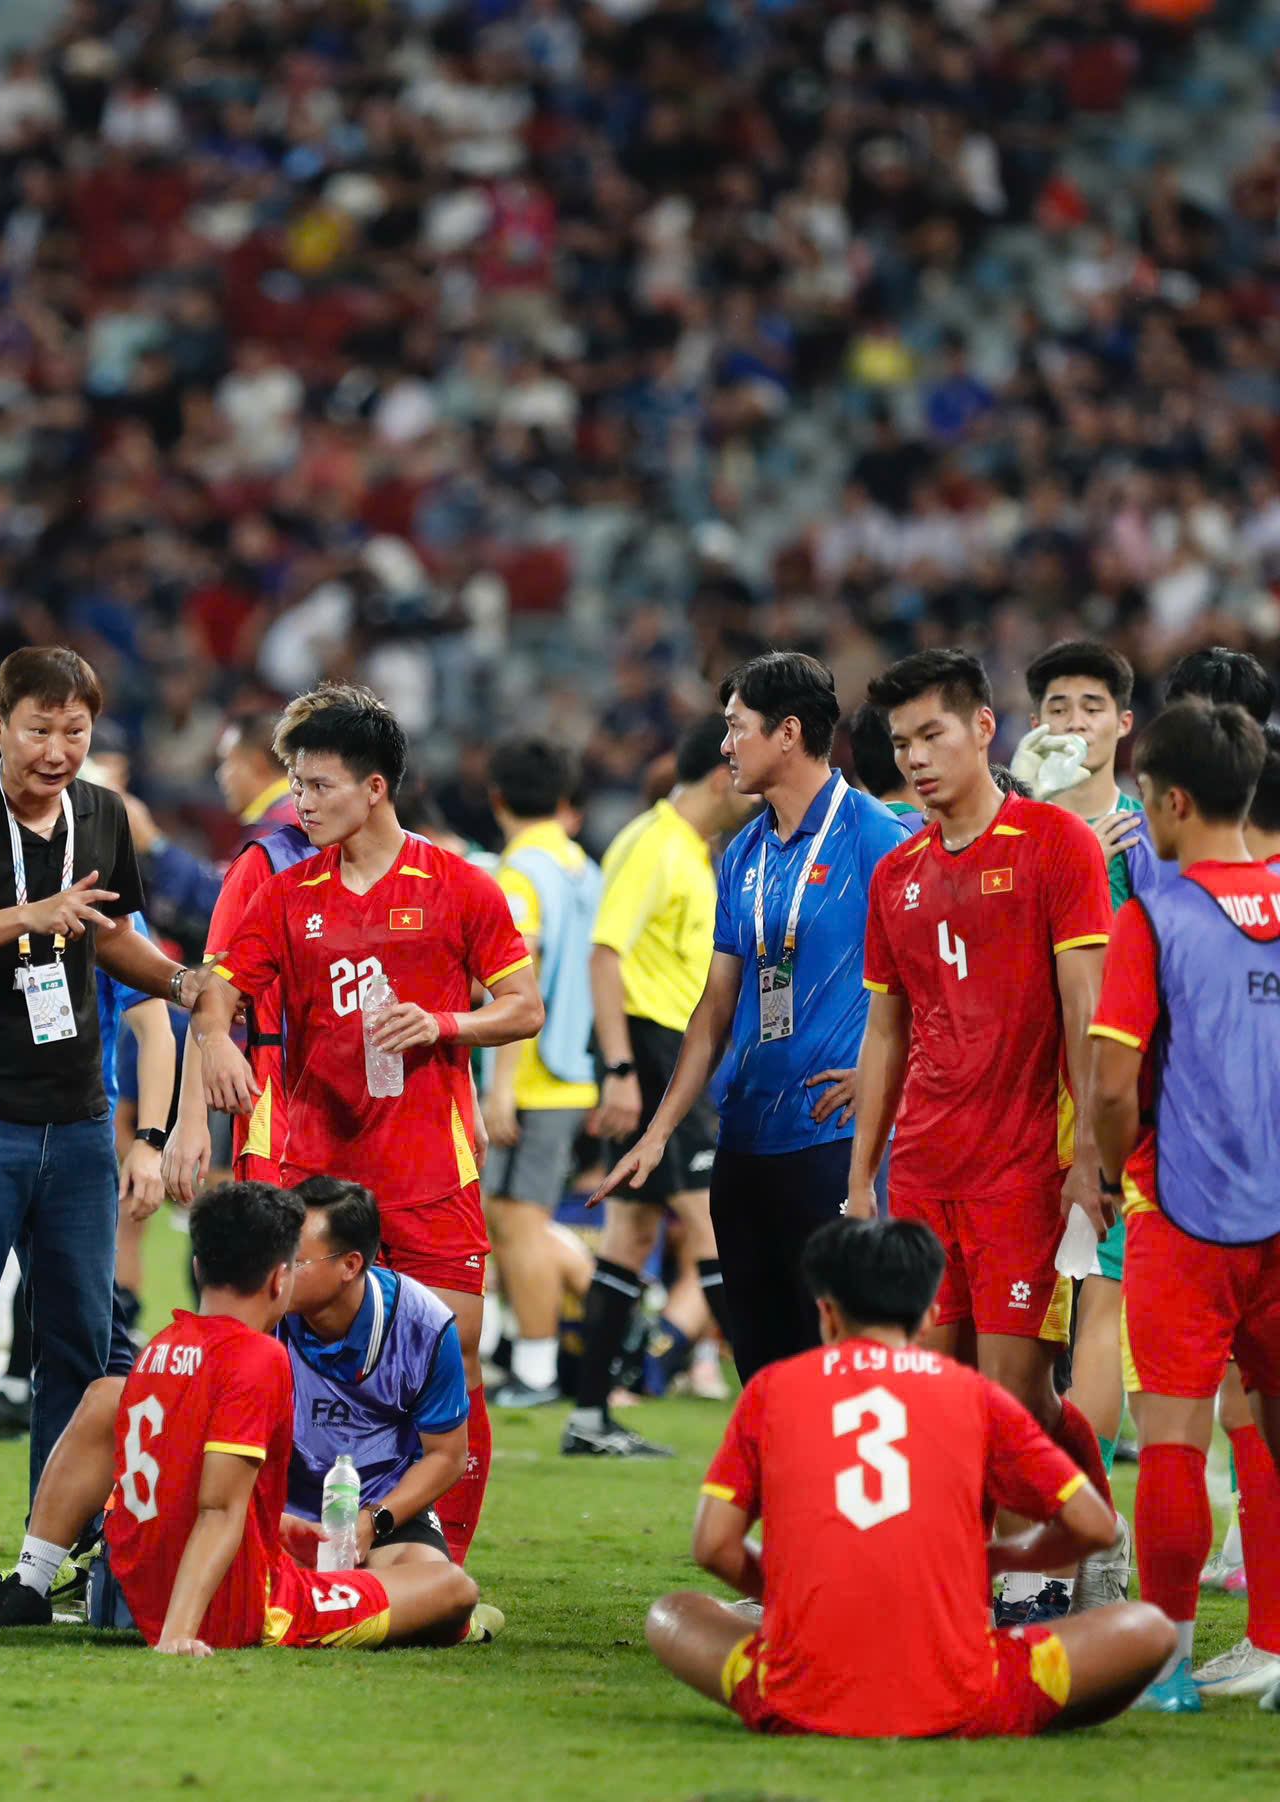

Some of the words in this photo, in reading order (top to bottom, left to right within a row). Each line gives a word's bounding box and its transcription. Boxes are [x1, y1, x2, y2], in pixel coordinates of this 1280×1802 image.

[937, 919, 969, 981] 4
[329, 956, 383, 1018] 22
[853, 1348, 888, 1371] LY
[893, 1351, 943, 1375] DUC
[312, 1398, 350, 1421] FA
[119, 1394, 165, 1523] 6
[832, 1384, 912, 1531] 3
